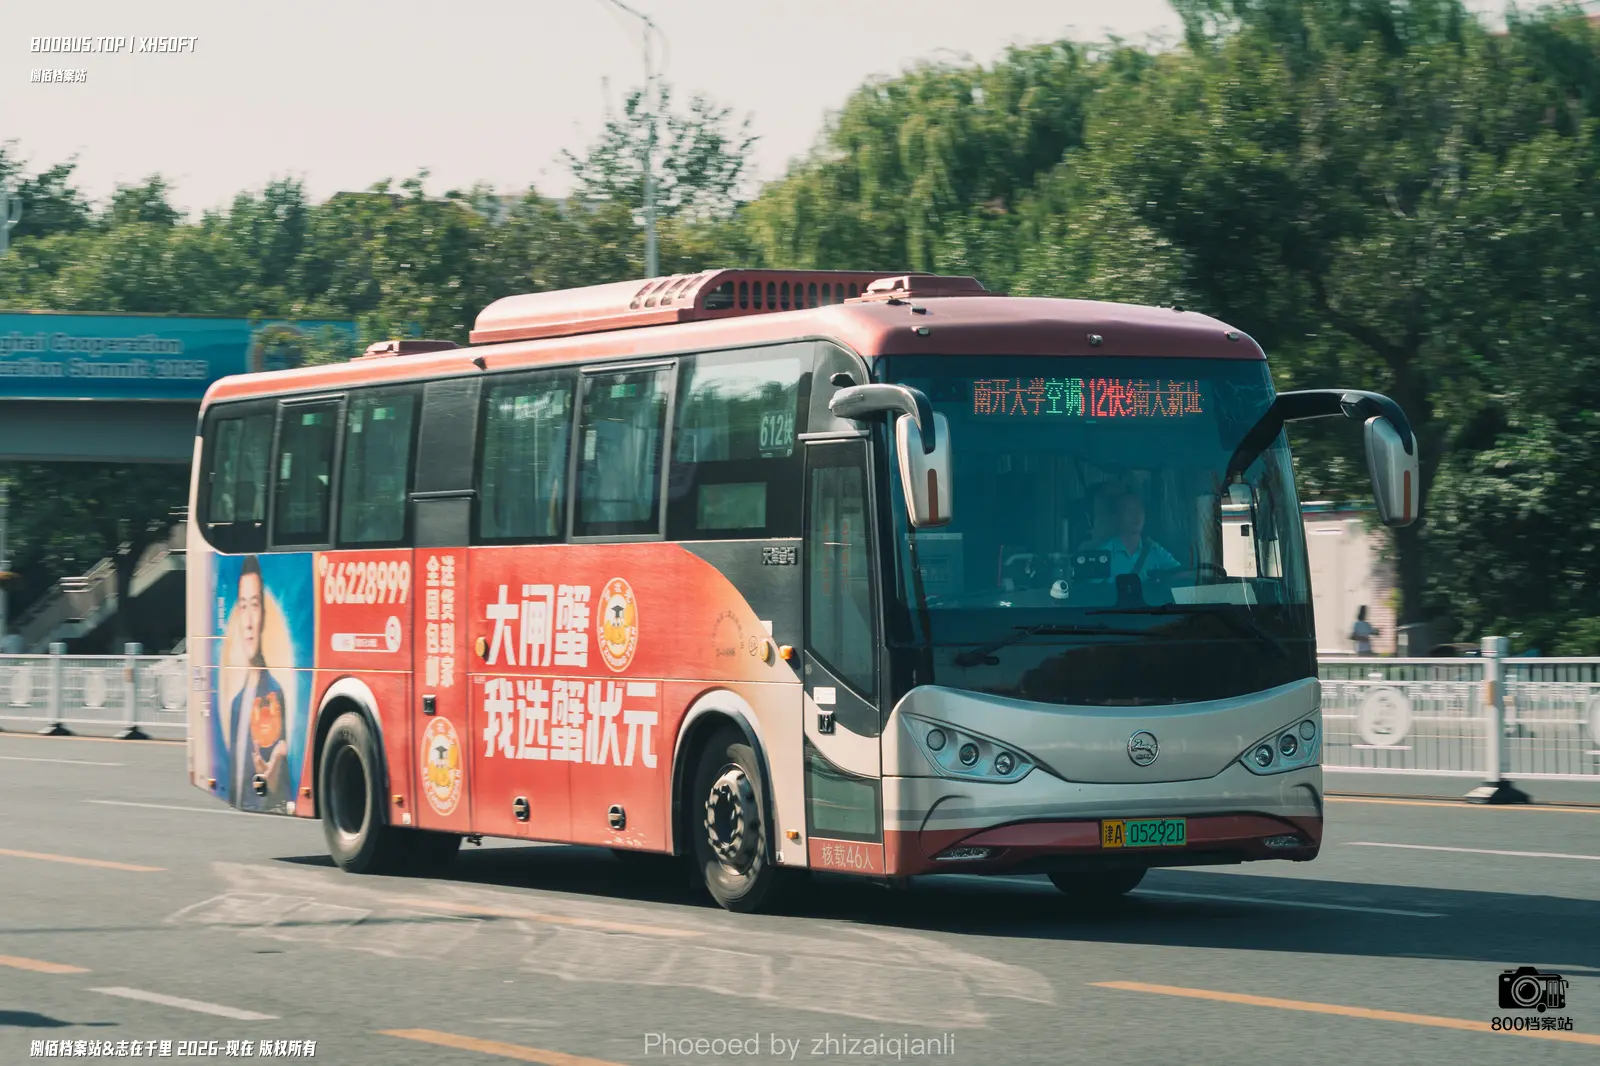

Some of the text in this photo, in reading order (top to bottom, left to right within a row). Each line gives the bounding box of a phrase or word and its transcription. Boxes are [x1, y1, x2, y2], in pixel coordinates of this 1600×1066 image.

[51, 332, 184, 357] Cooperation
[68, 358, 152, 378] Summit
[324, 561, 411, 605] 66228999
[425, 555, 440, 687] 全国包
[485, 584, 592, 668] 大闸蟹
[483, 677, 658, 769] 我选蟹状元
[1130, 822, 1185, 843] 05292D
[821, 843, 874, 870] 核载46人
